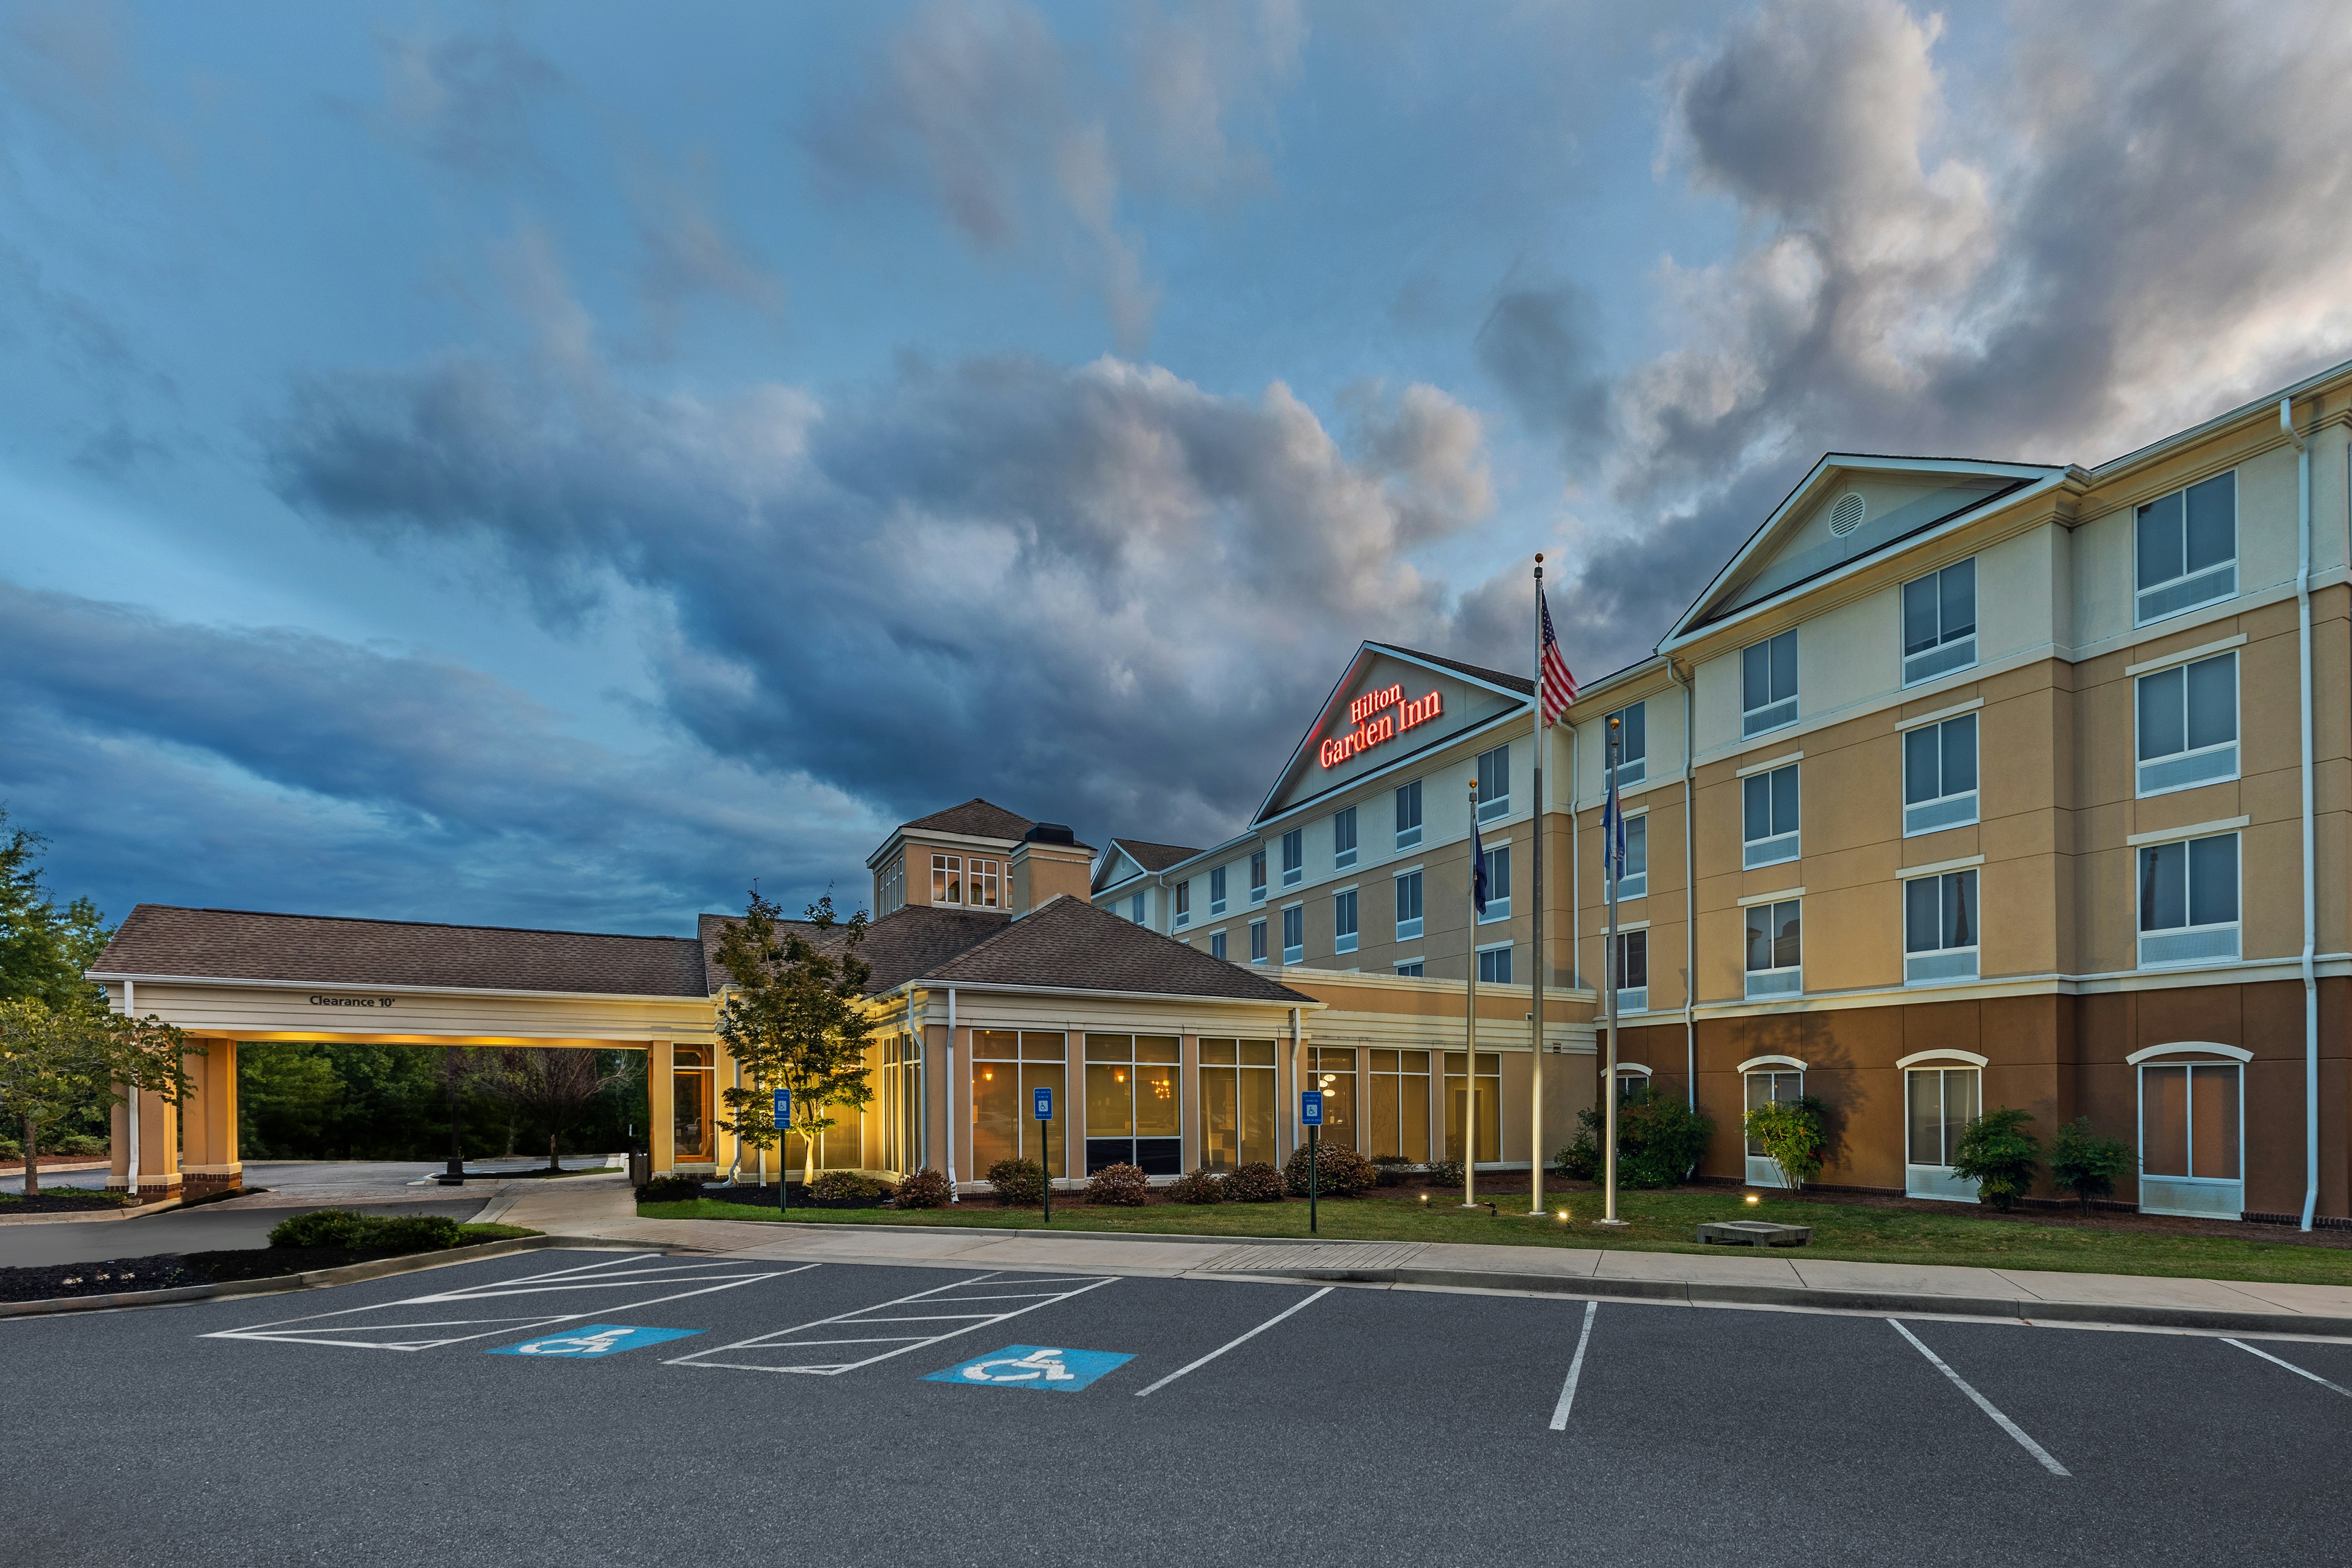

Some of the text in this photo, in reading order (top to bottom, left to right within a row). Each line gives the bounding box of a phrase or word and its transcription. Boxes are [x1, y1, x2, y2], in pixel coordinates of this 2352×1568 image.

[1350, 683, 1402, 724] Hilton
[1320, 690, 1441, 768] Garden Inn
[309, 995, 395, 1007] Clearance 10'
